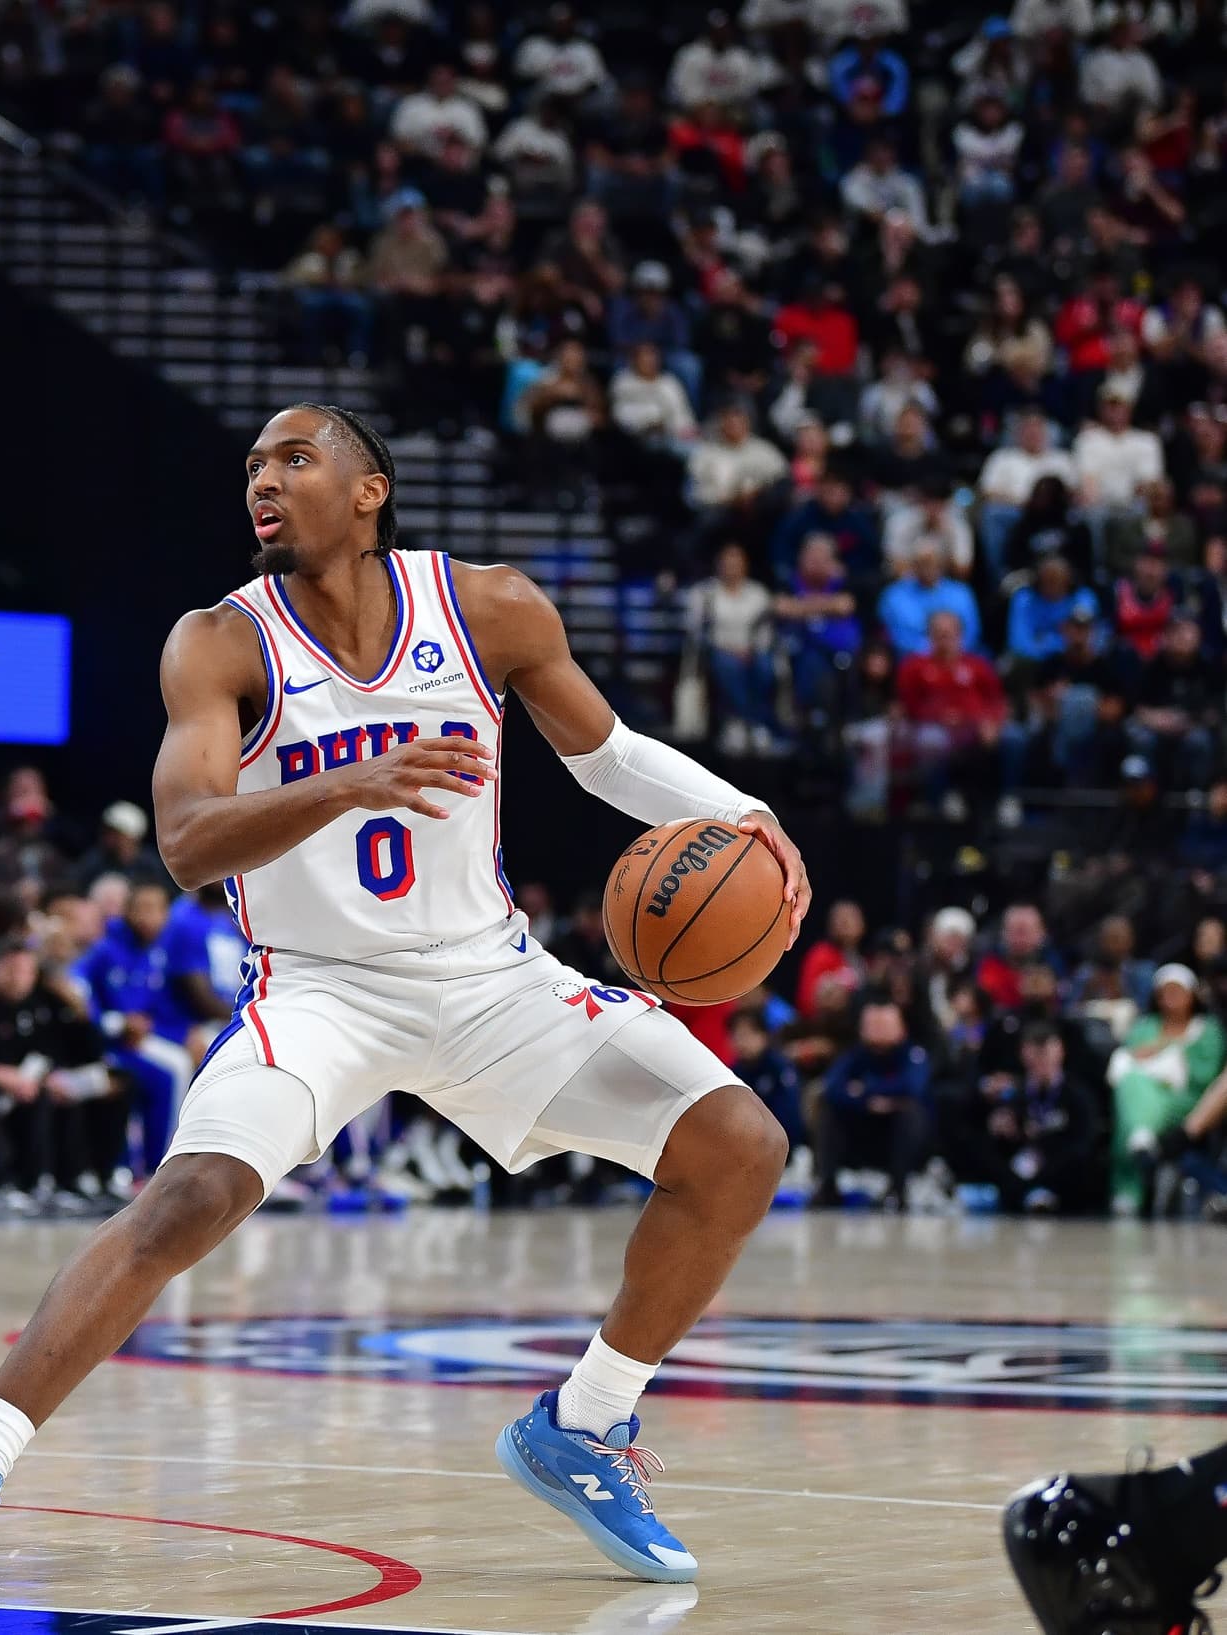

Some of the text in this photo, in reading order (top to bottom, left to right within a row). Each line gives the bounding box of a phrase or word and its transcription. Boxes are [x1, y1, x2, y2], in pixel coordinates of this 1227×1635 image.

[408, 671, 465, 694] crypto.com
[355, 815, 416, 902] 0
[646, 825, 740, 918] Wilson
